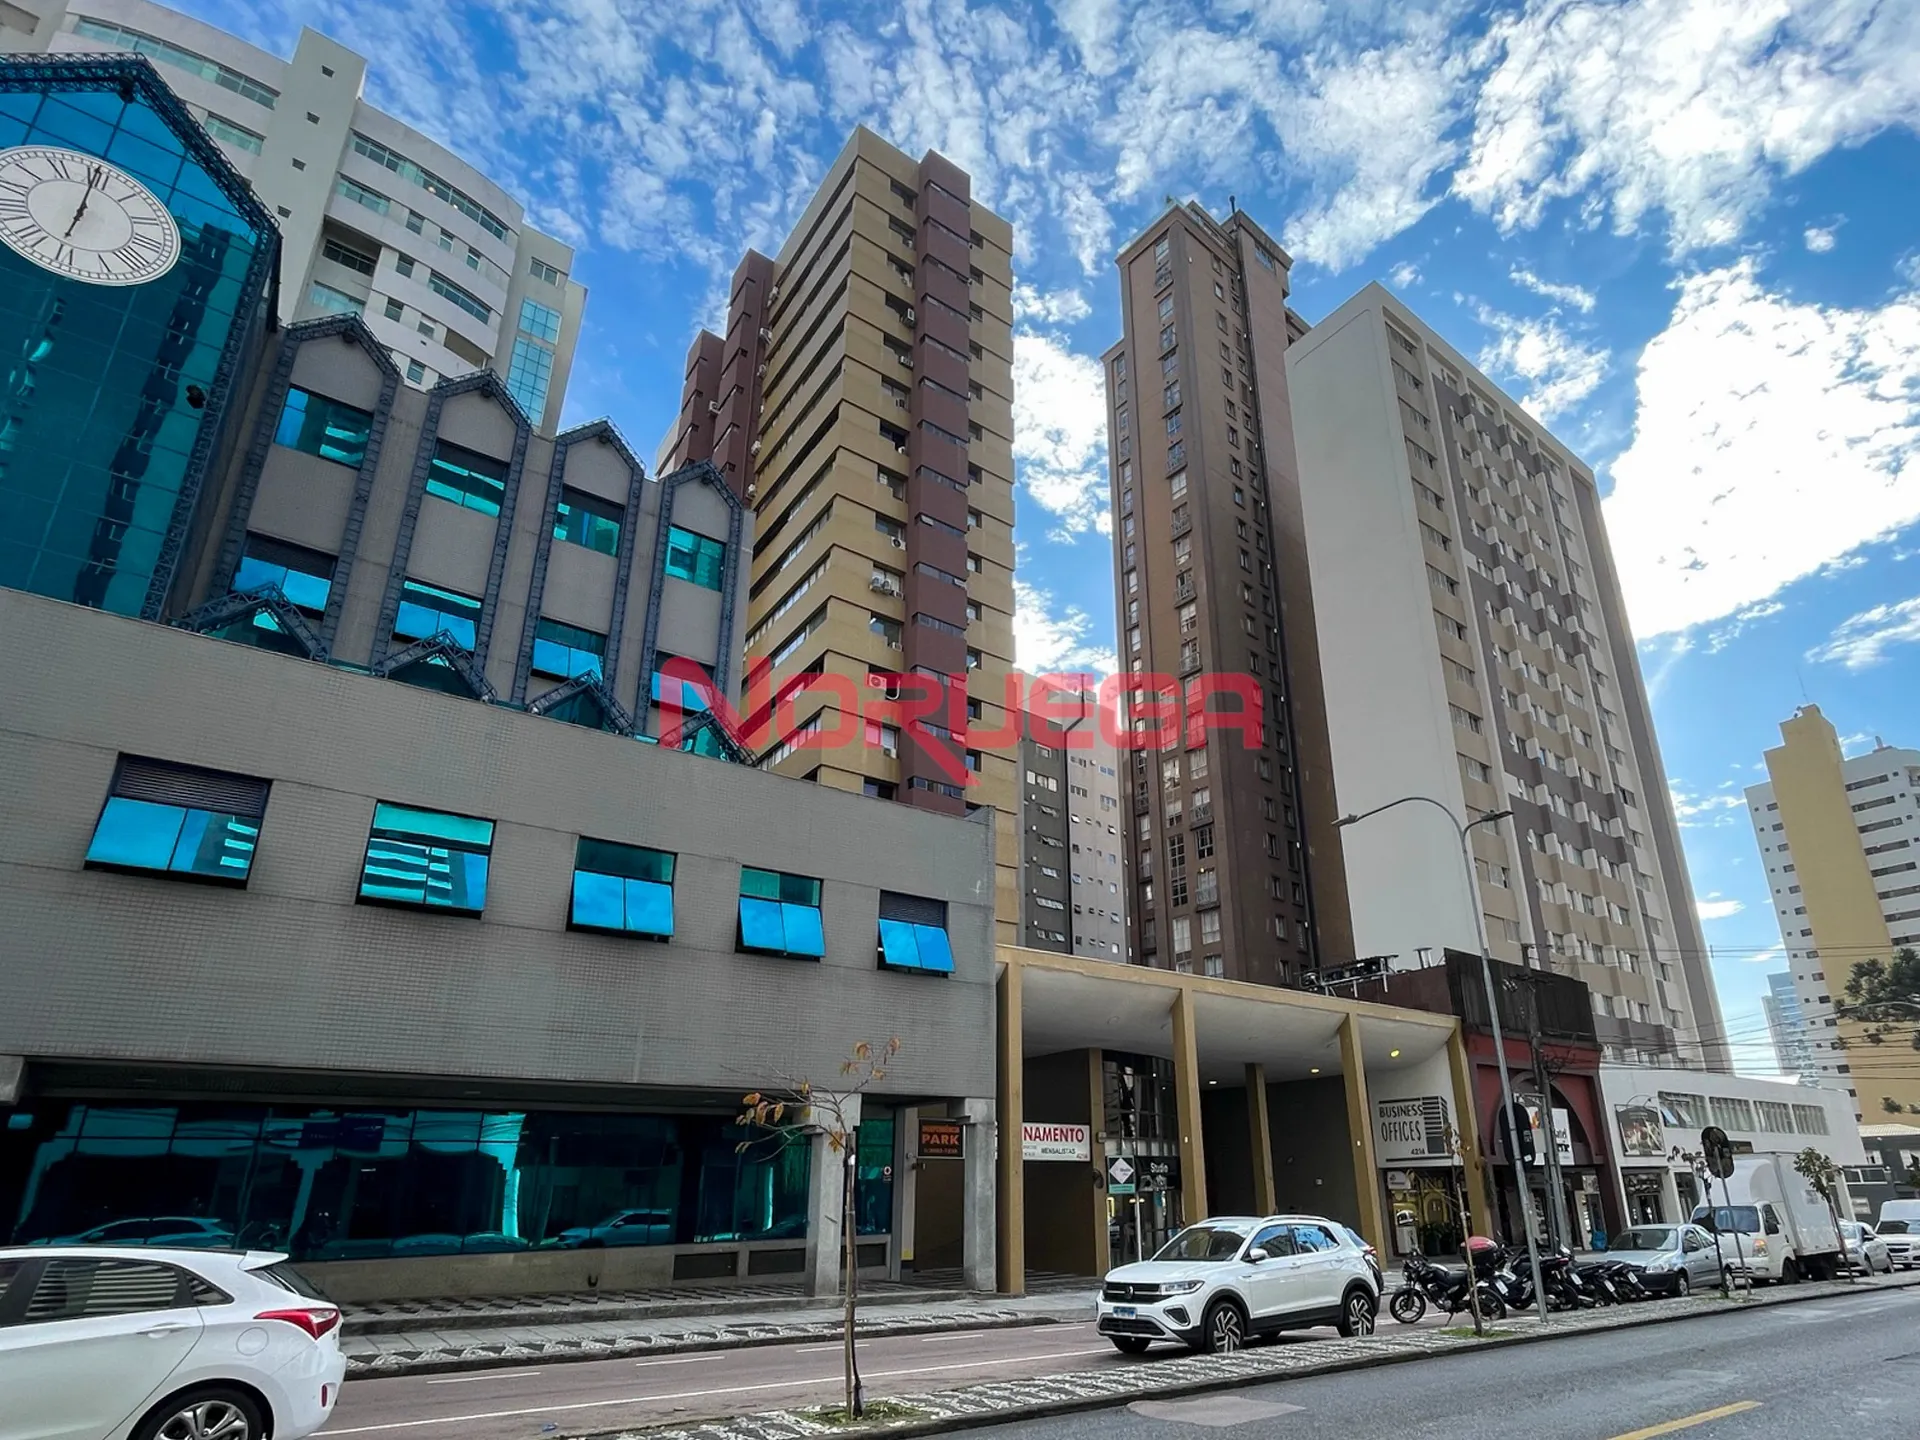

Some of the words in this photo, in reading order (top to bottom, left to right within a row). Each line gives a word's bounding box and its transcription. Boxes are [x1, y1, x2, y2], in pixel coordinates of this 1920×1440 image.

[1379, 1104, 1424, 1118] BUSINESS
[1024, 1126, 1085, 1143] NAMENTO
[1381, 1120, 1422, 1142] OFFICES
[922, 1133, 960, 1145] PARK
